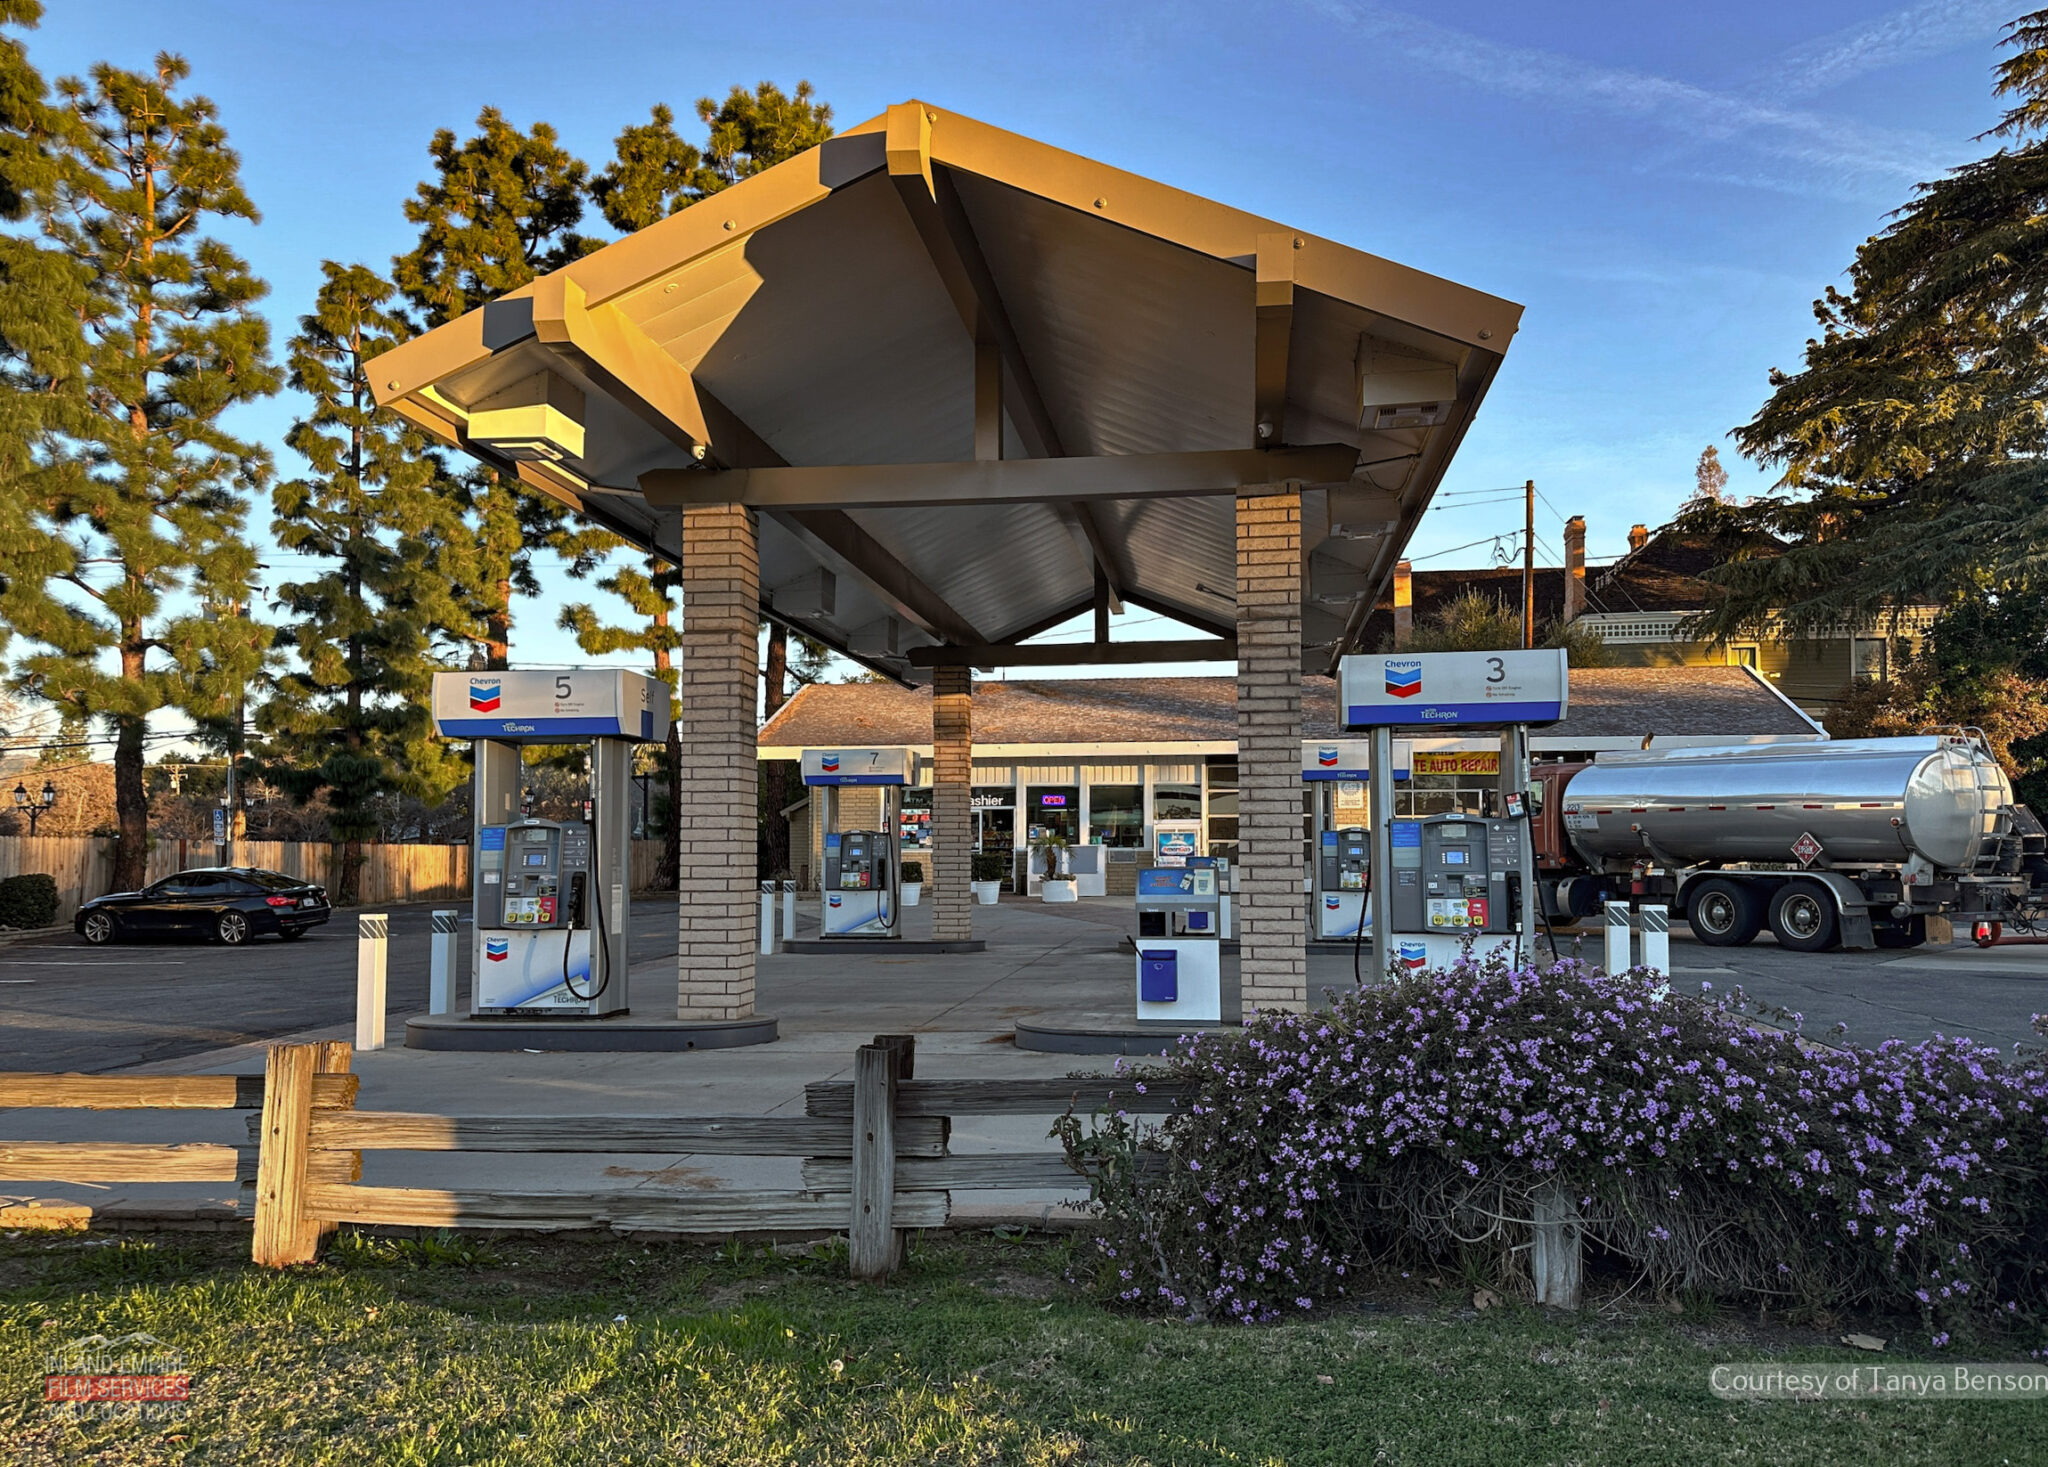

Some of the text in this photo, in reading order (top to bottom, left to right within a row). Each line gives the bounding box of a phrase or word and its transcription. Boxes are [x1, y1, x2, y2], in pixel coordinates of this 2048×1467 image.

[1385, 660, 1422, 668] Chevron
[1486, 657, 1506, 683] 3
[470, 677, 501, 685] Chevron
[555, 676, 572, 699] 5
[640, 688, 655, 704] Self
[1421, 710, 1458, 719] TECHRON
[870, 752, 879, 765] 7
[1430, 759, 1458, 772] AUTO
[1461, 759, 1498, 772] REPAIR
[970, 794, 1004, 806] ashier
[1043, 795, 1065, 805] OPEN
